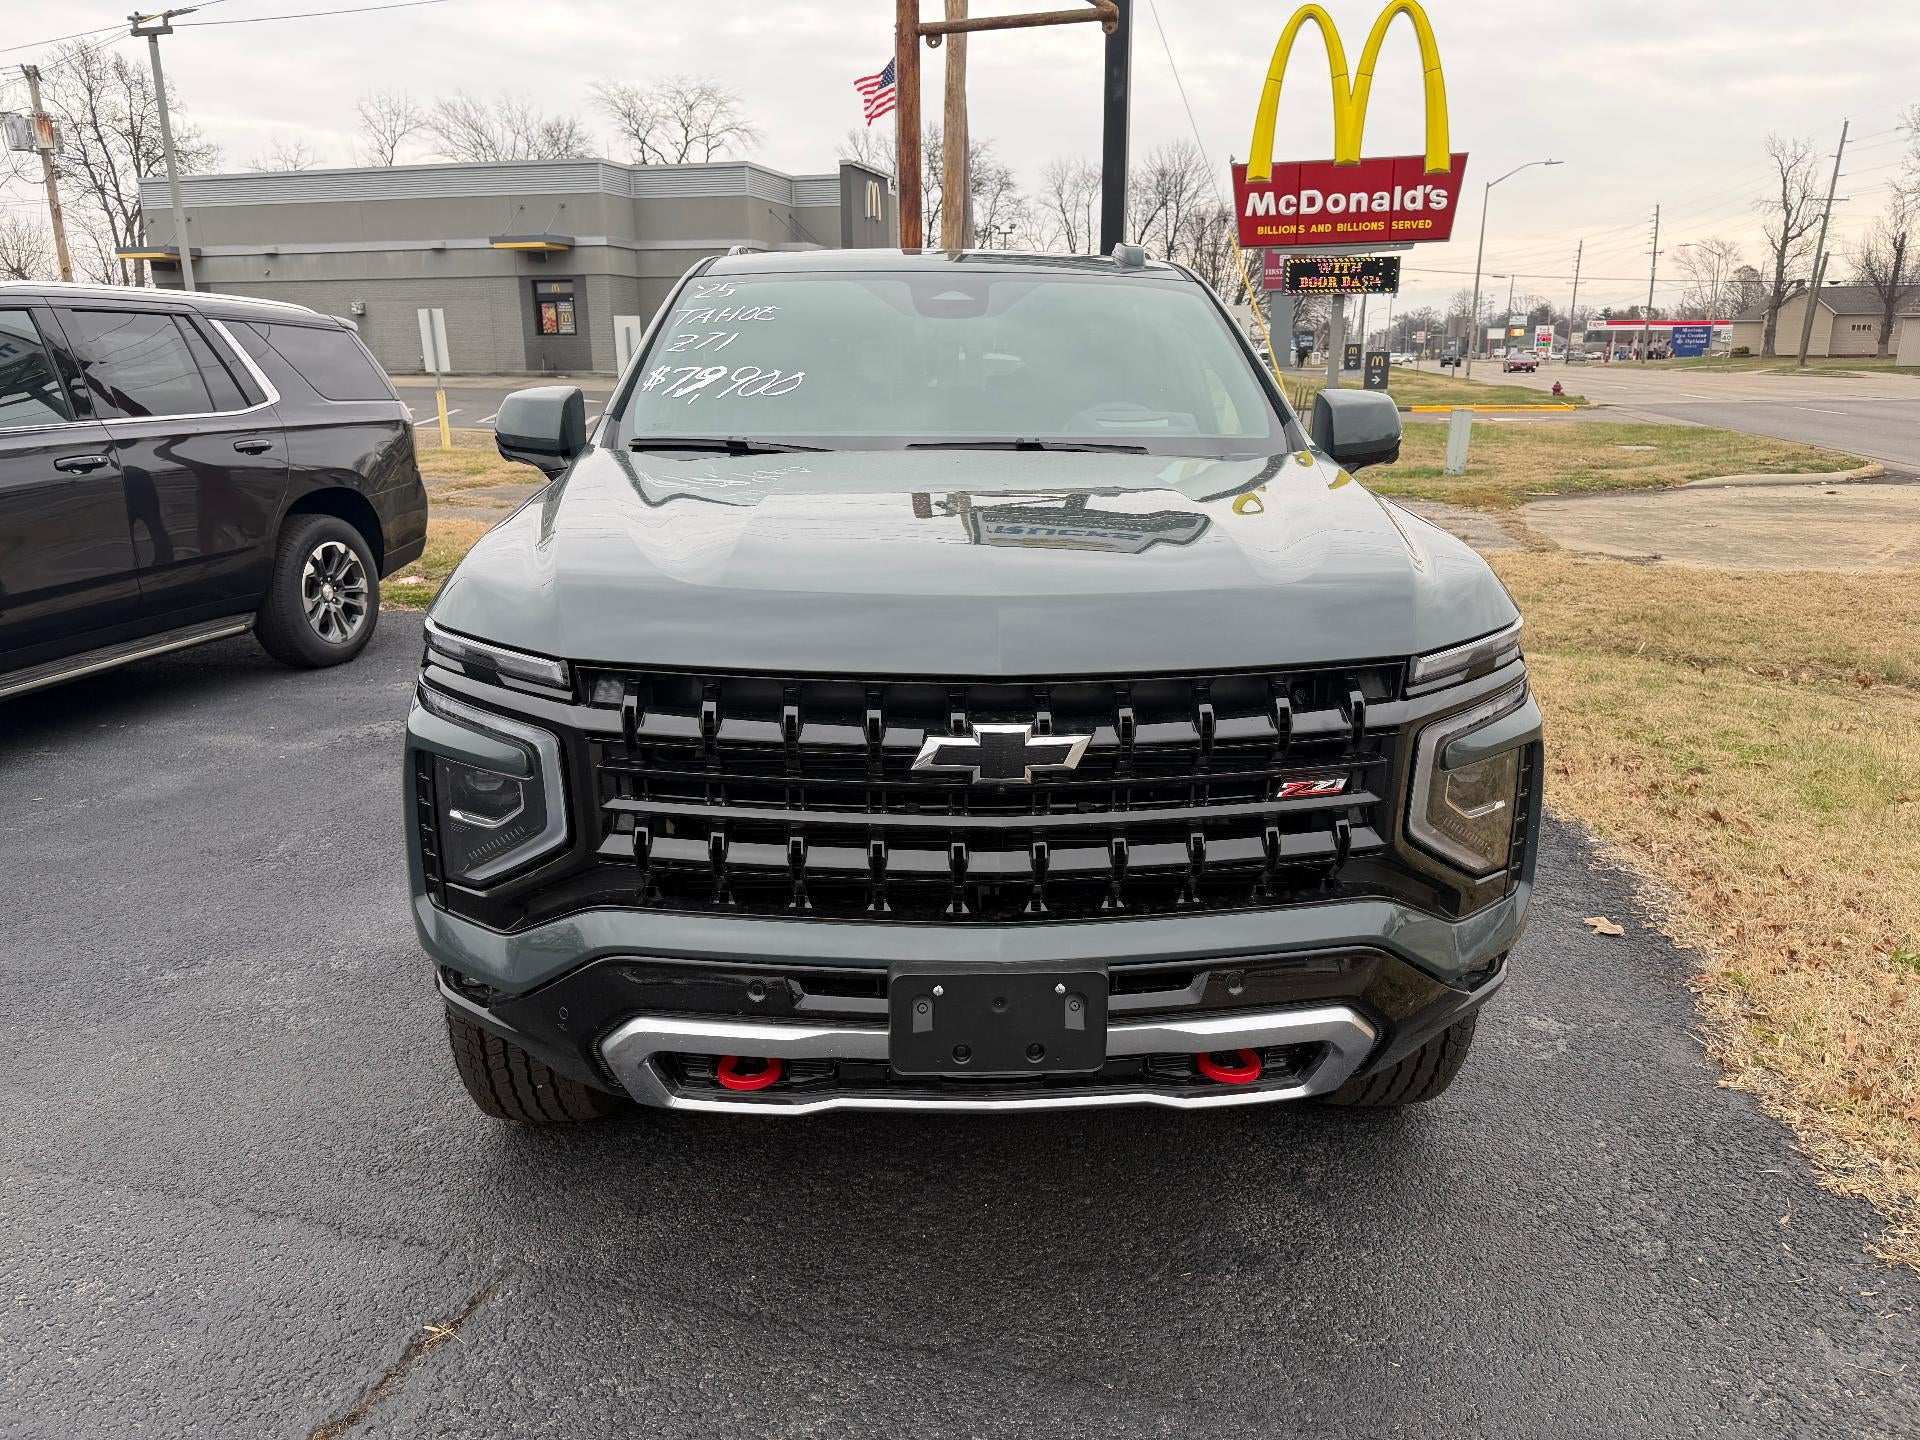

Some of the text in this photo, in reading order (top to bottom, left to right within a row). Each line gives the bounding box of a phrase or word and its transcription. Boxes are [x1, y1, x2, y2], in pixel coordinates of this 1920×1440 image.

[1245, 185, 1448, 217] McDonald's
[1257, 219, 1433, 235] BILLIONS AND BILLIONS SERVED
[1317, 262, 1363, 274] WITH
[1298, 275, 1382, 288] DOOR DASH
[674, 305, 782, 327] TAHOE
[1276, 778, 1347, 799] Z71
